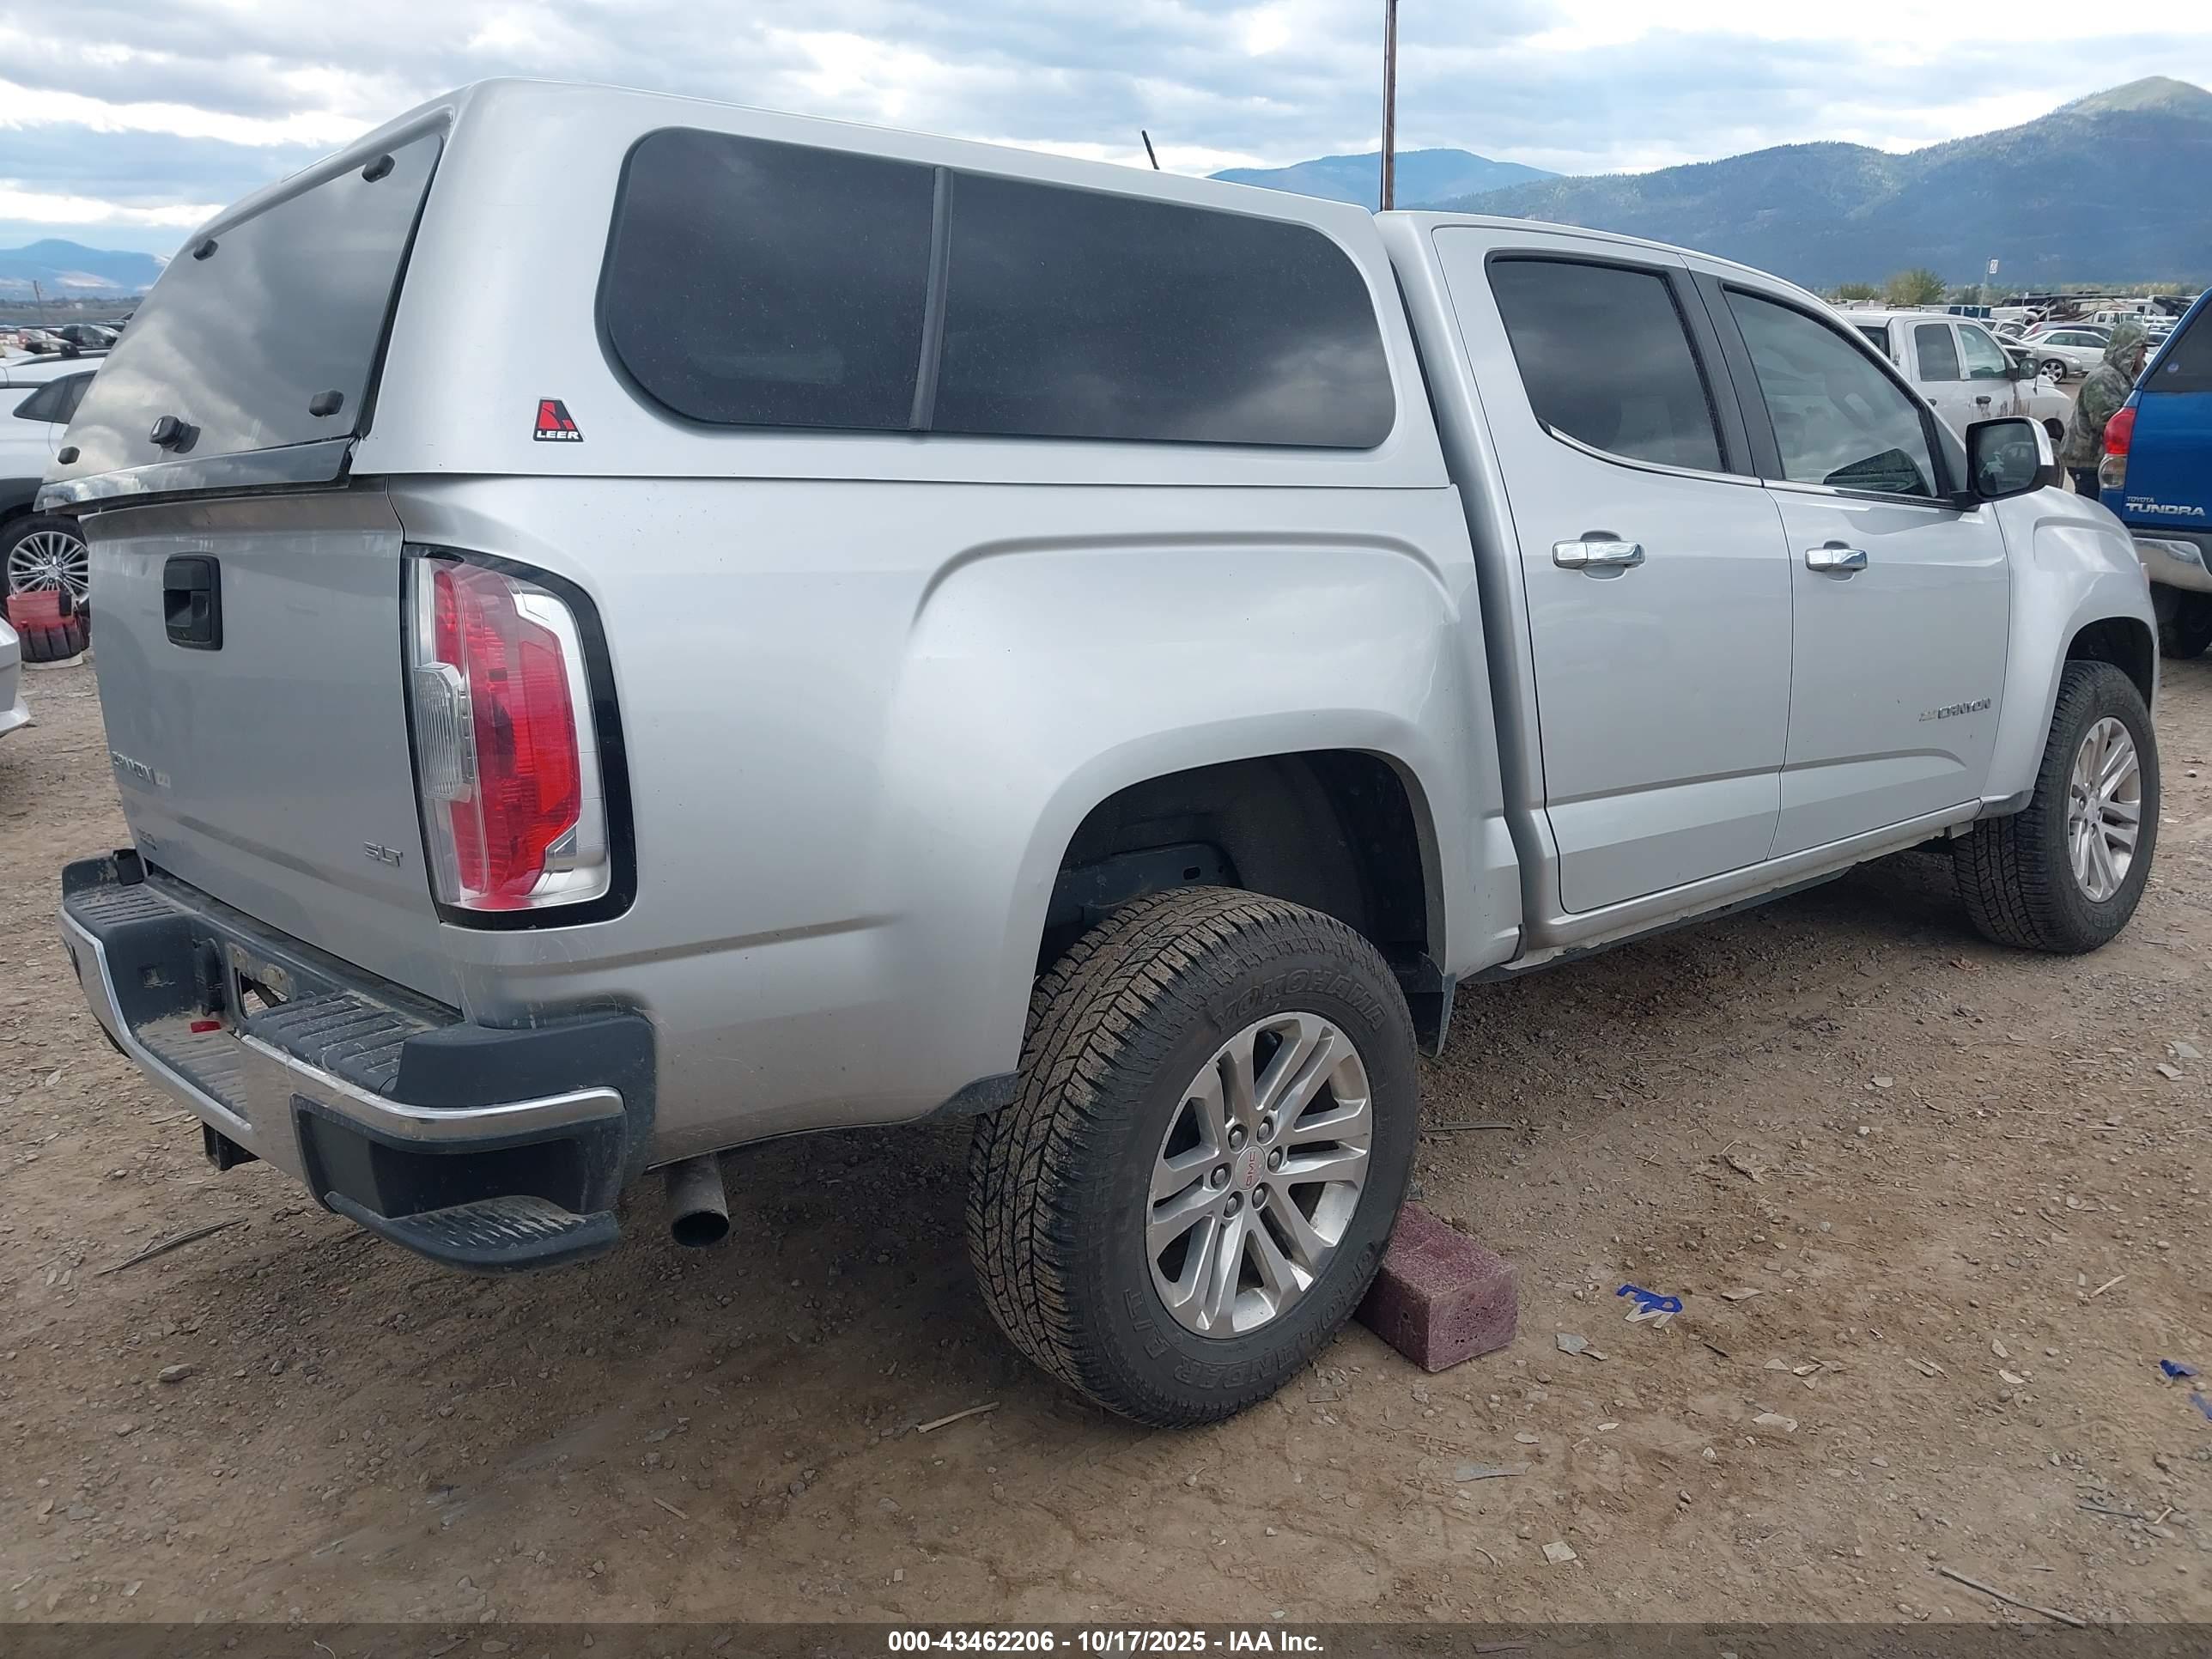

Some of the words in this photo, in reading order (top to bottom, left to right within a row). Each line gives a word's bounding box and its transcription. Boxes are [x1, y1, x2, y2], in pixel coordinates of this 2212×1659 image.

[537, 430, 579, 440] LEER
[2125, 503, 2205, 516] TUNDRA
[363, 841, 404, 867] SLT
[1214, 968, 1388, 1033] YOKOHAMA
[1245, 1150, 1256, 1187] GMC
